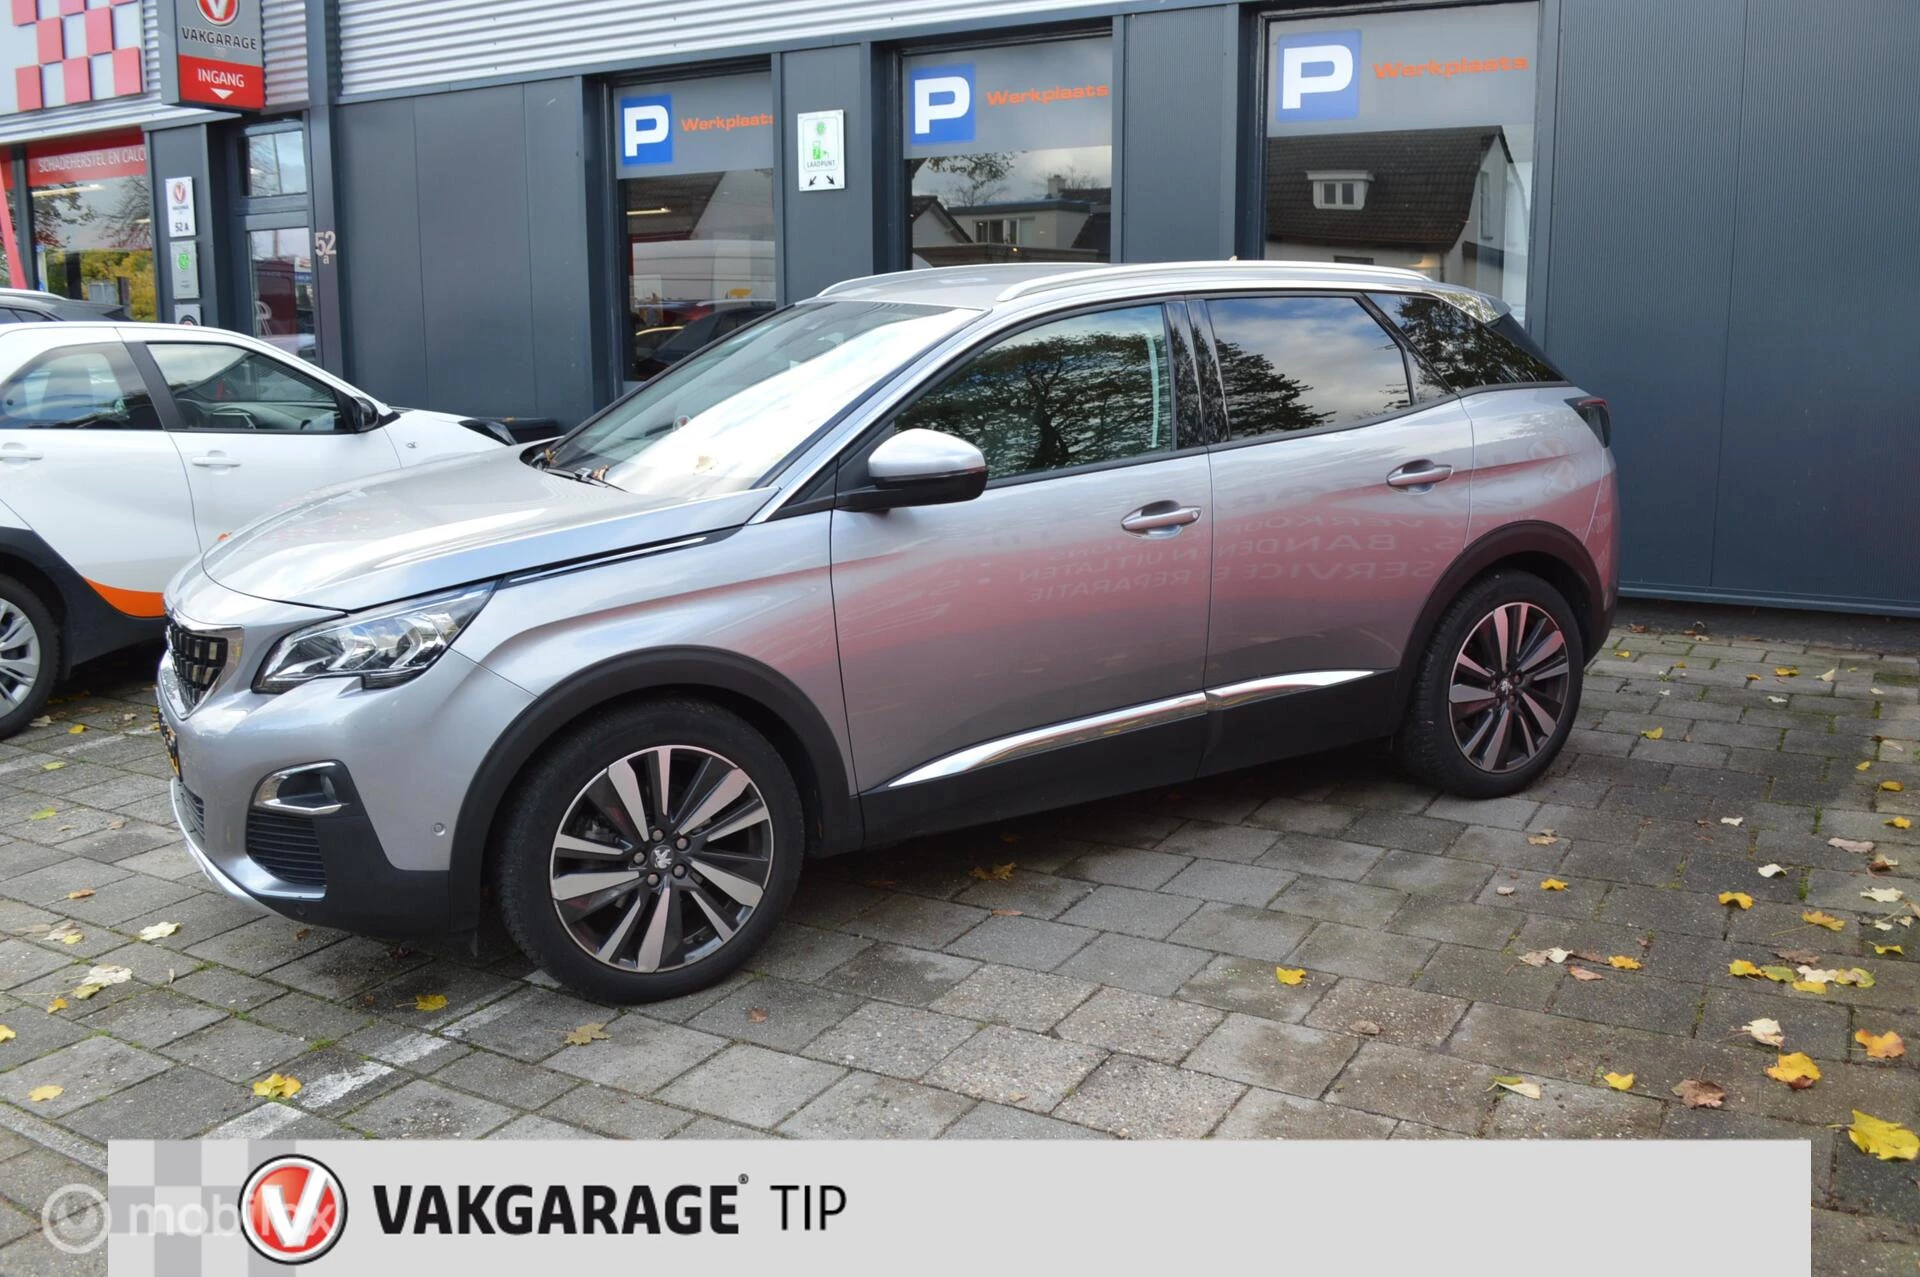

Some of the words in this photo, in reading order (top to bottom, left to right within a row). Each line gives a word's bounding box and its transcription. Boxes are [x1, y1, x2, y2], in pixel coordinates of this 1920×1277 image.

[181, 27, 258, 50] VAKGARAGE
[197, 68, 245, 88] INGANG
[1282, 44, 1353, 110] P
[1372, 56, 1529, 79] Werkplaats
[914, 75, 971, 135] P
[985, 82, 1109, 108] Werkplaats
[624, 104, 669, 157] P
[806, 160, 836, 168] LAADPUNT
[315, 231, 337, 256] 52
[322, 254, 330, 265] a
